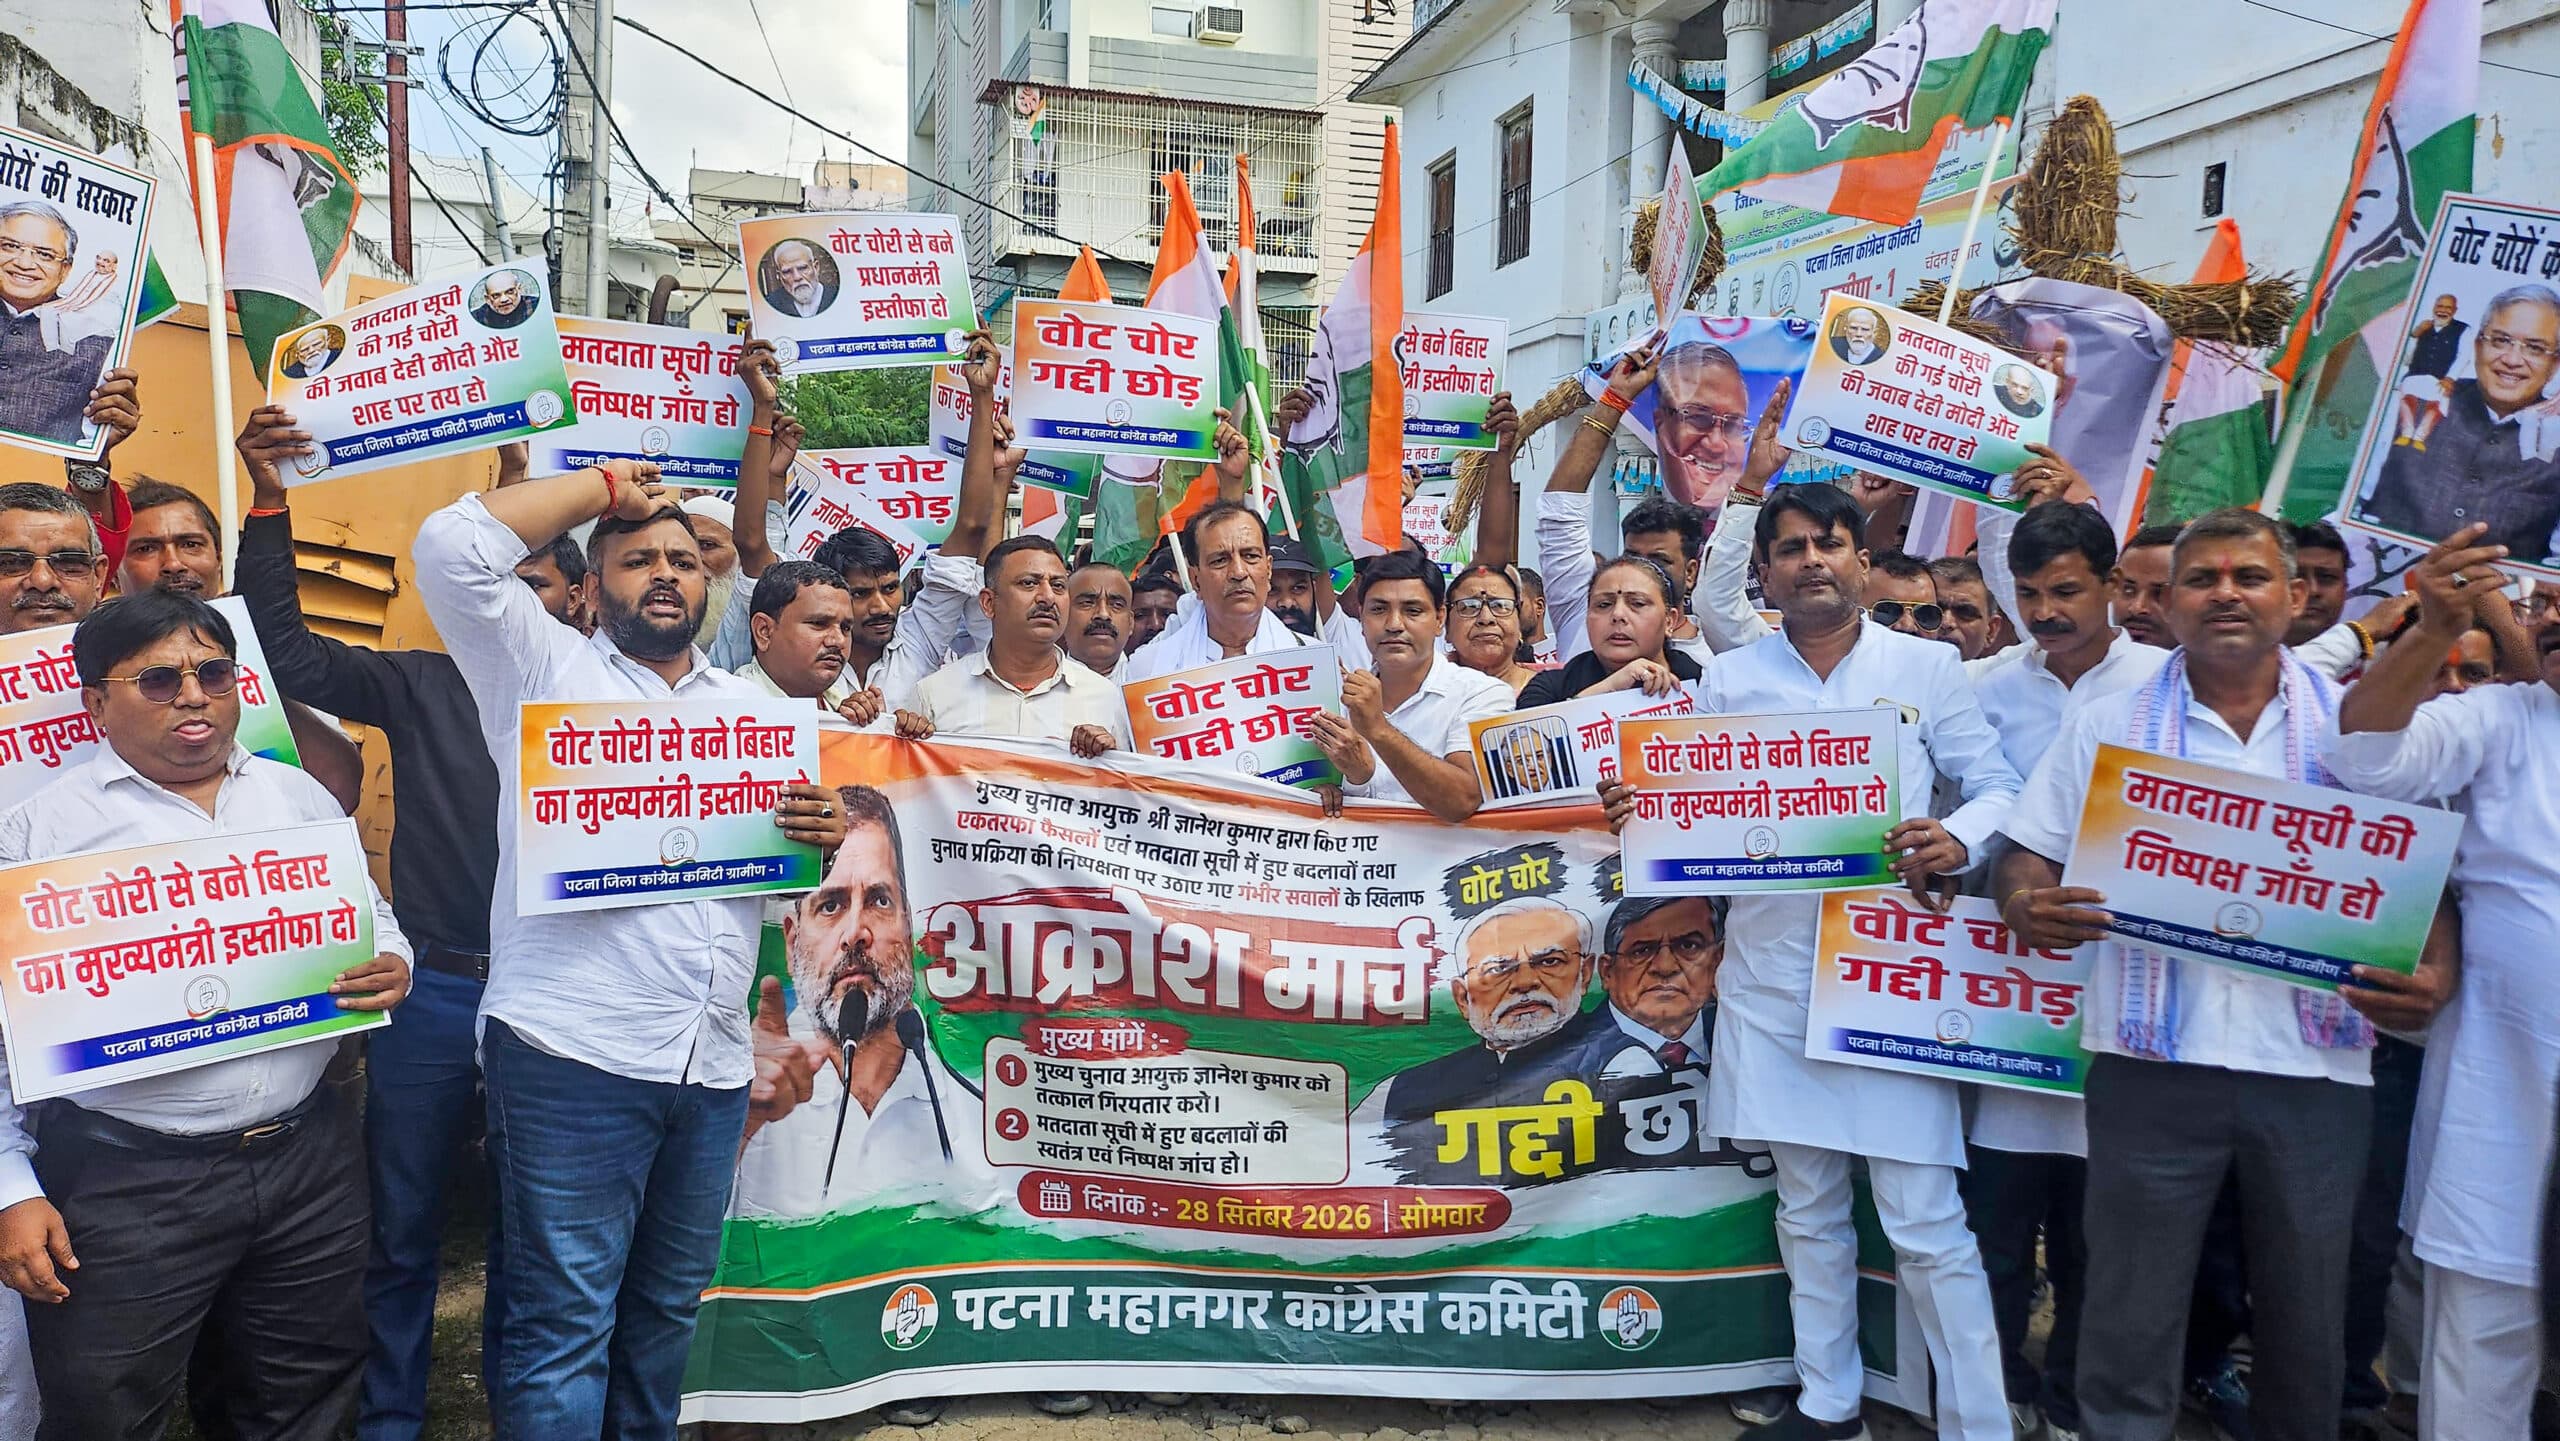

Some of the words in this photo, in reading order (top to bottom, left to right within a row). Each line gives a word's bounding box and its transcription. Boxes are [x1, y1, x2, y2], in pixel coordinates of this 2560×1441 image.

[41, 161, 71, 202] की
[77, 177, 137, 225] सरकार
[829, 228, 861, 254] वोट
[864, 228, 903, 254] चोरी
[905, 228, 923, 253] से
[925, 229, 954, 254] बने
[1806, 254, 1828, 274] पटना
[1829, 245, 1854, 268] जिला
[1856, 233, 1885, 261] कांग्रेस
[2449, 216, 2491, 265] वोट
[2491, 223, 2546, 274] चोरों
[857, 261, 940, 286] प्रधानमंत्री
[351, 302, 419, 332] मतदाता
[422, 284, 462, 315] सूची
[860, 293, 927, 322] इस्तीफा
[929, 293, 948, 319] दो
[357, 335, 381, 357] की
[386, 328, 413, 350] गई
[417, 316, 459, 342] चोरी
[560, 335, 655, 369] मतदाता
[661, 341, 712, 382] सूची
[810, 344, 836, 354] पटना
[837, 342, 876, 354] महानगर
[878, 338, 906, 351] कांग्रेस
[908, 337, 936, 350] कमिटी
[1038, 313, 1117, 350] वोट
[1125, 322, 1198, 359] चोर
[1404, 325, 1419, 353] से
[1422, 328, 1446, 355] बने
[1450, 329, 1489, 358] बिहार
[305, 378, 330, 400] की
[334, 365, 387, 393] जवाब
[391, 354, 425, 381] देही
[429, 343, 475, 373] मोदी
[481, 336, 519, 363] और
[1032, 359, 1115, 394] गद्दी
[1123, 364, 1203, 407] छोड़
[1424, 365, 1477, 393] इस्तीफा
[1480, 367, 1495, 395] दो
[353, 399, 392, 427] शाह
[396, 392, 425, 417] पर
[428, 385, 461, 410] तय
[463, 376, 487, 402] हो
[660, 385, 708, 424] जाँच
[713, 394, 739, 426] हो
[1409, 422, 1433, 432] कांग्रेस
[1434, 424, 1460, 434] कमिटी
[875, 455, 947, 483] चोर
[1148, 681, 1225, 719] वोट
[1232, 665, 1313, 699] चोर
[1154, 718, 1234, 760] गद्दी
[1644, 737, 1681, 773] वोट
[1687, 732, 1734, 771] चोरी
[1738, 732, 1760, 769] से
[1765, 731, 1803, 768] बने
[1809, 729, 1871, 766] बिहार
[534, 789, 569, 824] का
[574, 773, 693, 835] मुख्यमंत्री
[976, 780, 1021, 804] मुख्य
[1025, 790, 1072, 814] चुनाव
[1078, 799, 1140, 828] आयुक्त
[1147, 807, 1170, 830] श्री
[1175, 814, 1223, 837] ज्ञानेश
[1227, 822, 1274, 846] कुमार
[1277, 829, 1310, 849] द्वारा
[1314, 829, 1347, 852] किए
[1352, 836, 1379, 851] गए
[2126, 771, 2264, 832] मतदाता
[2270, 804, 2355, 855] सूची
[2360, 814, 2417, 862] की
[957, 811, 1035, 834] एकतरफा
[1041, 820, 1101, 848] फैसलों
[1104, 833, 1131, 855] एवं
[1135, 840, 1199, 867] मतदाता
[1203, 849, 1240, 876] सूची
[1244, 853, 1260, 874] में
[1263, 859, 1288, 881] हुए
[1293, 861, 1358, 880] बदलावों
[1363, 863, 1397, 880] तथा
[25, 882, 85, 929] वोट
[88, 867, 158, 919] चोरी
[162, 861, 195, 908] से
[198, 854, 249, 901] बने
[252, 850, 330, 893] बिहार
[931, 838, 967, 863] चुनाव
[971, 839, 1027, 864] प्रक्रिया
[1031, 844, 1058, 867] की
[1058, 848, 1134, 881] निष्पक्षता
[1135, 868, 1157, 887] पर
[1161, 874, 1202, 896] उठाए
[1207, 883, 1234, 899] गए
[1239, 882, 1282, 904] गंभीर
[1286, 887, 1340, 907] सवालों
[1344, 888, 1361, 906] के
[1365, 888, 1425, 907] खिलाफ
[1460, 866, 1504, 905] वोट
[1508, 853, 1551, 893] चोर
[2123, 830, 2249, 894] निष्पक्ष
[2256, 859, 2333, 911] जाँच
[2339, 877, 2384, 921] हो
[1848, 898, 1954, 947] वोट
[16, 954, 65, 995] का
[69, 918, 216, 998] मुख्यमंत्री
[220, 907, 322, 964] इस्तीफा
[327, 898, 356, 941] दो
[926, 885, 1250, 1008] आक्रोश
[1264, 916, 1432, 1020] मार्च
[1839, 956, 1949, 1001] गद्दी
[1960, 966, 2084, 1026] छोड़
[103, 1040, 146, 1058] पटना
[148, 1026, 212, 1049] महानगर
[216, 1013, 260, 1038] कांग्रेस
[263, 1002, 309, 1028] कमिटी
[1040, 1026, 1094, 1054] मुख्य
[1100, 1022, 1145, 1051] मांगें
[1006, 1062, 1016, 1079] 1
[1034, 1062, 1073, 1084] मुख्य
[1079, 1067, 1126, 1088] चुनाव
[1131, 1067, 1188, 1091] आयुक्त
[1194, 1066, 1248, 1085] ज्ञानेश
[1252, 1072, 1301, 1091] कुमार
[1305, 1073, 1331, 1092] को
[1036, 1087, 1094, 1109] तत्काल
[1005, 1115, 1019, 1133] 2
[1037, 1115, 1097, 1138] मतदाता
[1101, 1119, 1137, 1145] सूची
[1141, 1122, 1156, 1144] में
[1160, 1127, 1186, 1149] हुए
[1191, 1122, 1258, 1144] बदलावों
[1263, 1122, 1289, 1144] की
[1434, 1080, 1603, 1178] गद्दी
[1037, 1141, 1083, 1163] स्वतंत्र
[1089, 1144, 1114, 1163] एवं
[1118, 1151, 1175, 1170] निष्पक्ष
[1178, 1151, 1215, 1174] जांच
[1082, 1185, 1147, 1215] दिनांक
[1177, 1198, 1209, 1222] 28
[1217, 1198, 1293, 1229] सितंबर
[1302, 1206, 1371, 1230] 2026
[1400, 1197, 1487, 1230] सोमवार
[952, 1287, 1073, 1328] पटना
[1087, 1287, 1272, 1335] महानगर
[1283, 1283, 1430, 1335] कांग्रेस
[1438, 1280, 1590, 1340] कमिटी
